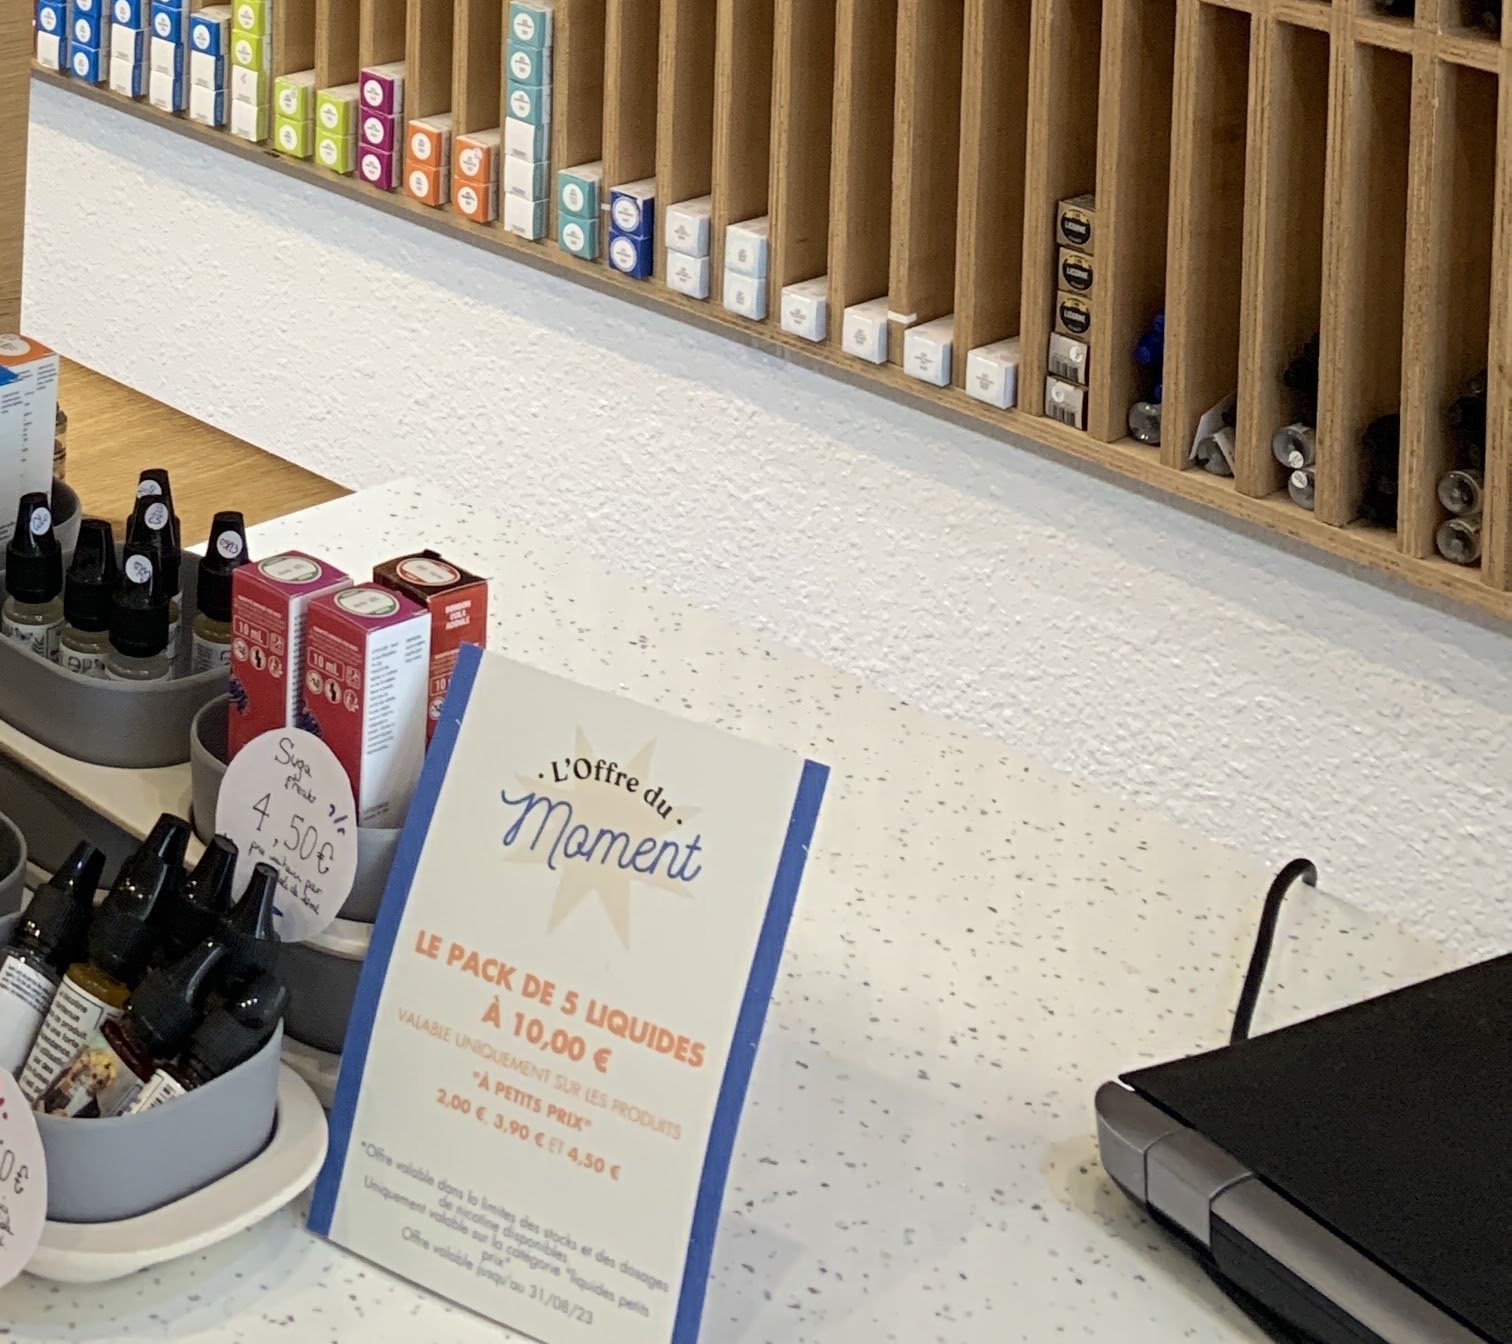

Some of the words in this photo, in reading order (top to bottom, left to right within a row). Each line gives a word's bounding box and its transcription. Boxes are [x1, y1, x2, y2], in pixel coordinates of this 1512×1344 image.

[237, 620, 249, 637] 10
[311, 651, 324, 668] 10
[551, 758, 640, 794] L'Offre
[644, 787, 674, 820] du
[251, 792, 335, 875] 4,50€
[501, 789, 703, 883] Moment
[414, 929, 442, 960] LE
[445, 944, 515, 992] PACK
[520, 974, 558, 1006] DE
[561, 991, 579, 1016] 5
[585, 997, 706, 1069] LIQUIDES
[481, 994, 504, 1029] À
[512, 1011, 587, 1063] 10,00
[594, 1044, 613, 1074] €
[397, 1008, 452, 1045] VALABLE
[455, 1028, 552, 1086] UNIQUEMENT
[555, 1073, 582, 1098] SUR
[585, 1083, 609, 1107] LES
[611, 1095, 684, 1141] PRODUITS
